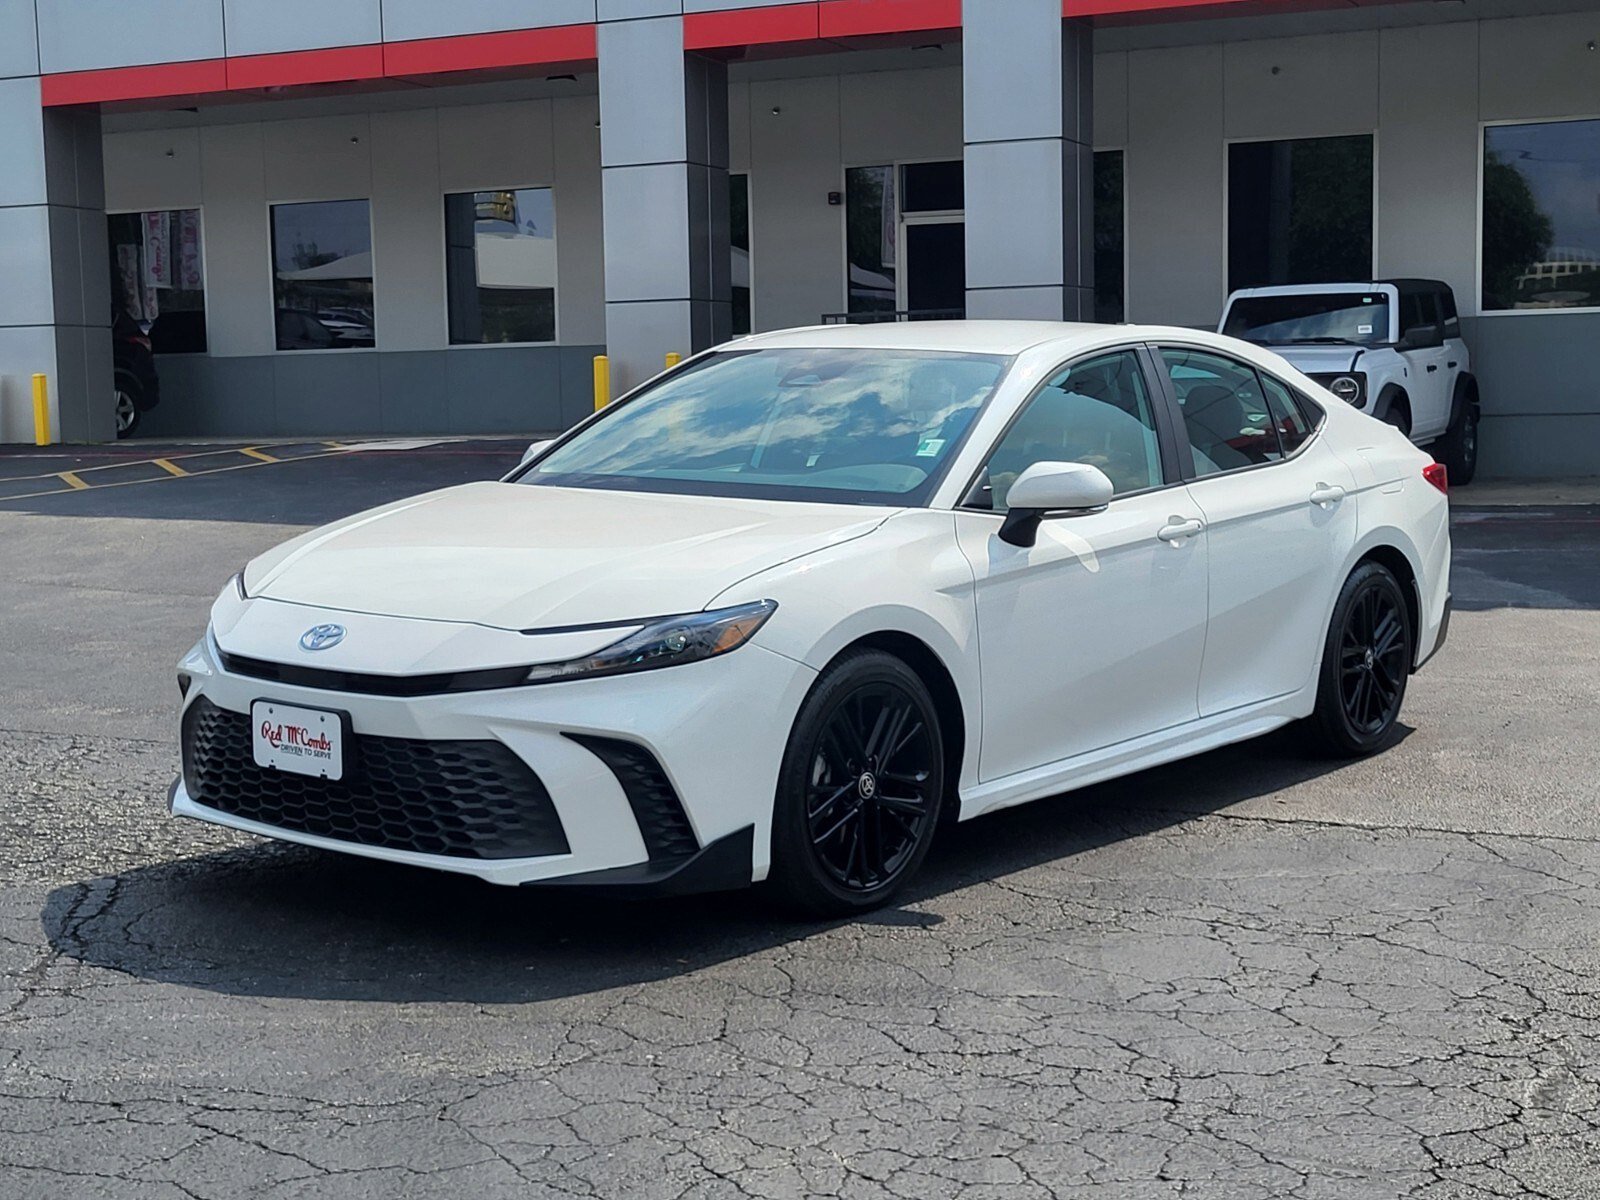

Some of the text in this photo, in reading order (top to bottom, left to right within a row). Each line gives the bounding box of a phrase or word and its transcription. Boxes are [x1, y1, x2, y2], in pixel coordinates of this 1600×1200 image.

[261, 720, 331, 751] Red McCombs
[280, 744, 331, 760] DRIVEN TO SERVE
